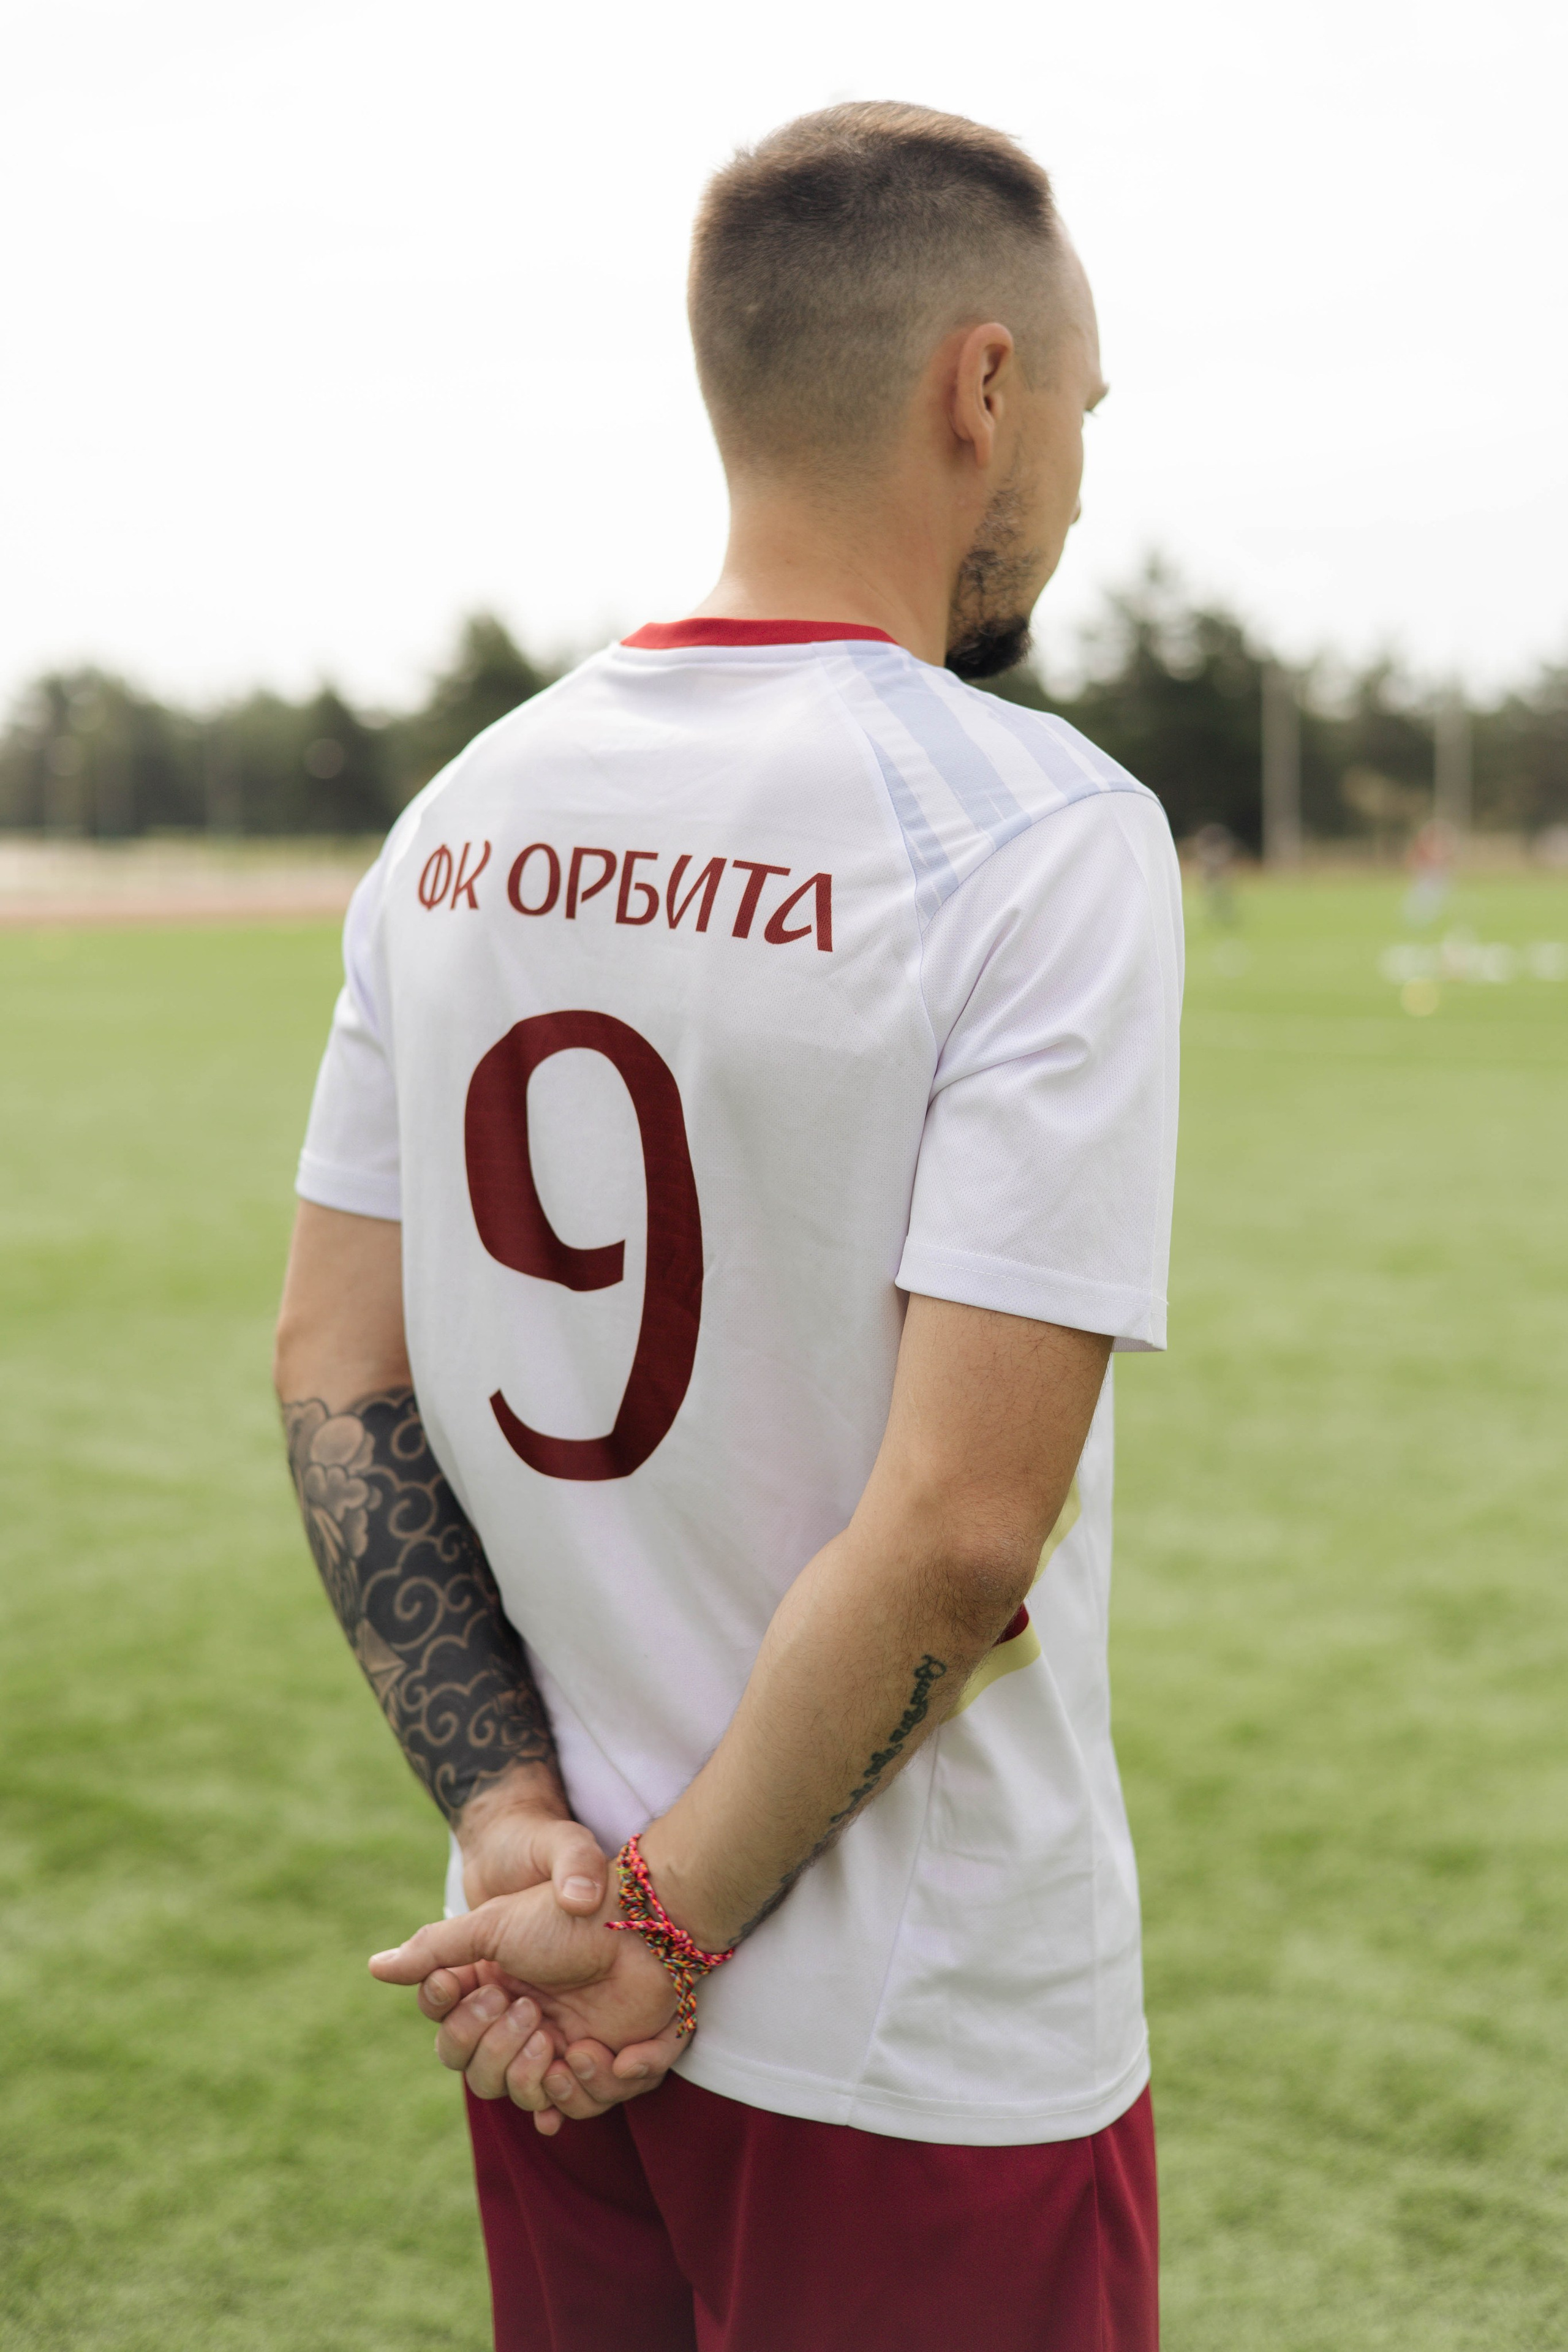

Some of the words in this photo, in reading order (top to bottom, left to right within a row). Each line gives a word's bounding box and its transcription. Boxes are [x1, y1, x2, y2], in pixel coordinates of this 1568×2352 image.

[418, 840, 491, 910] ФК
[507, 843, 834, 952] ОРБИТА
[464, 1010, 703, 1481] 9
